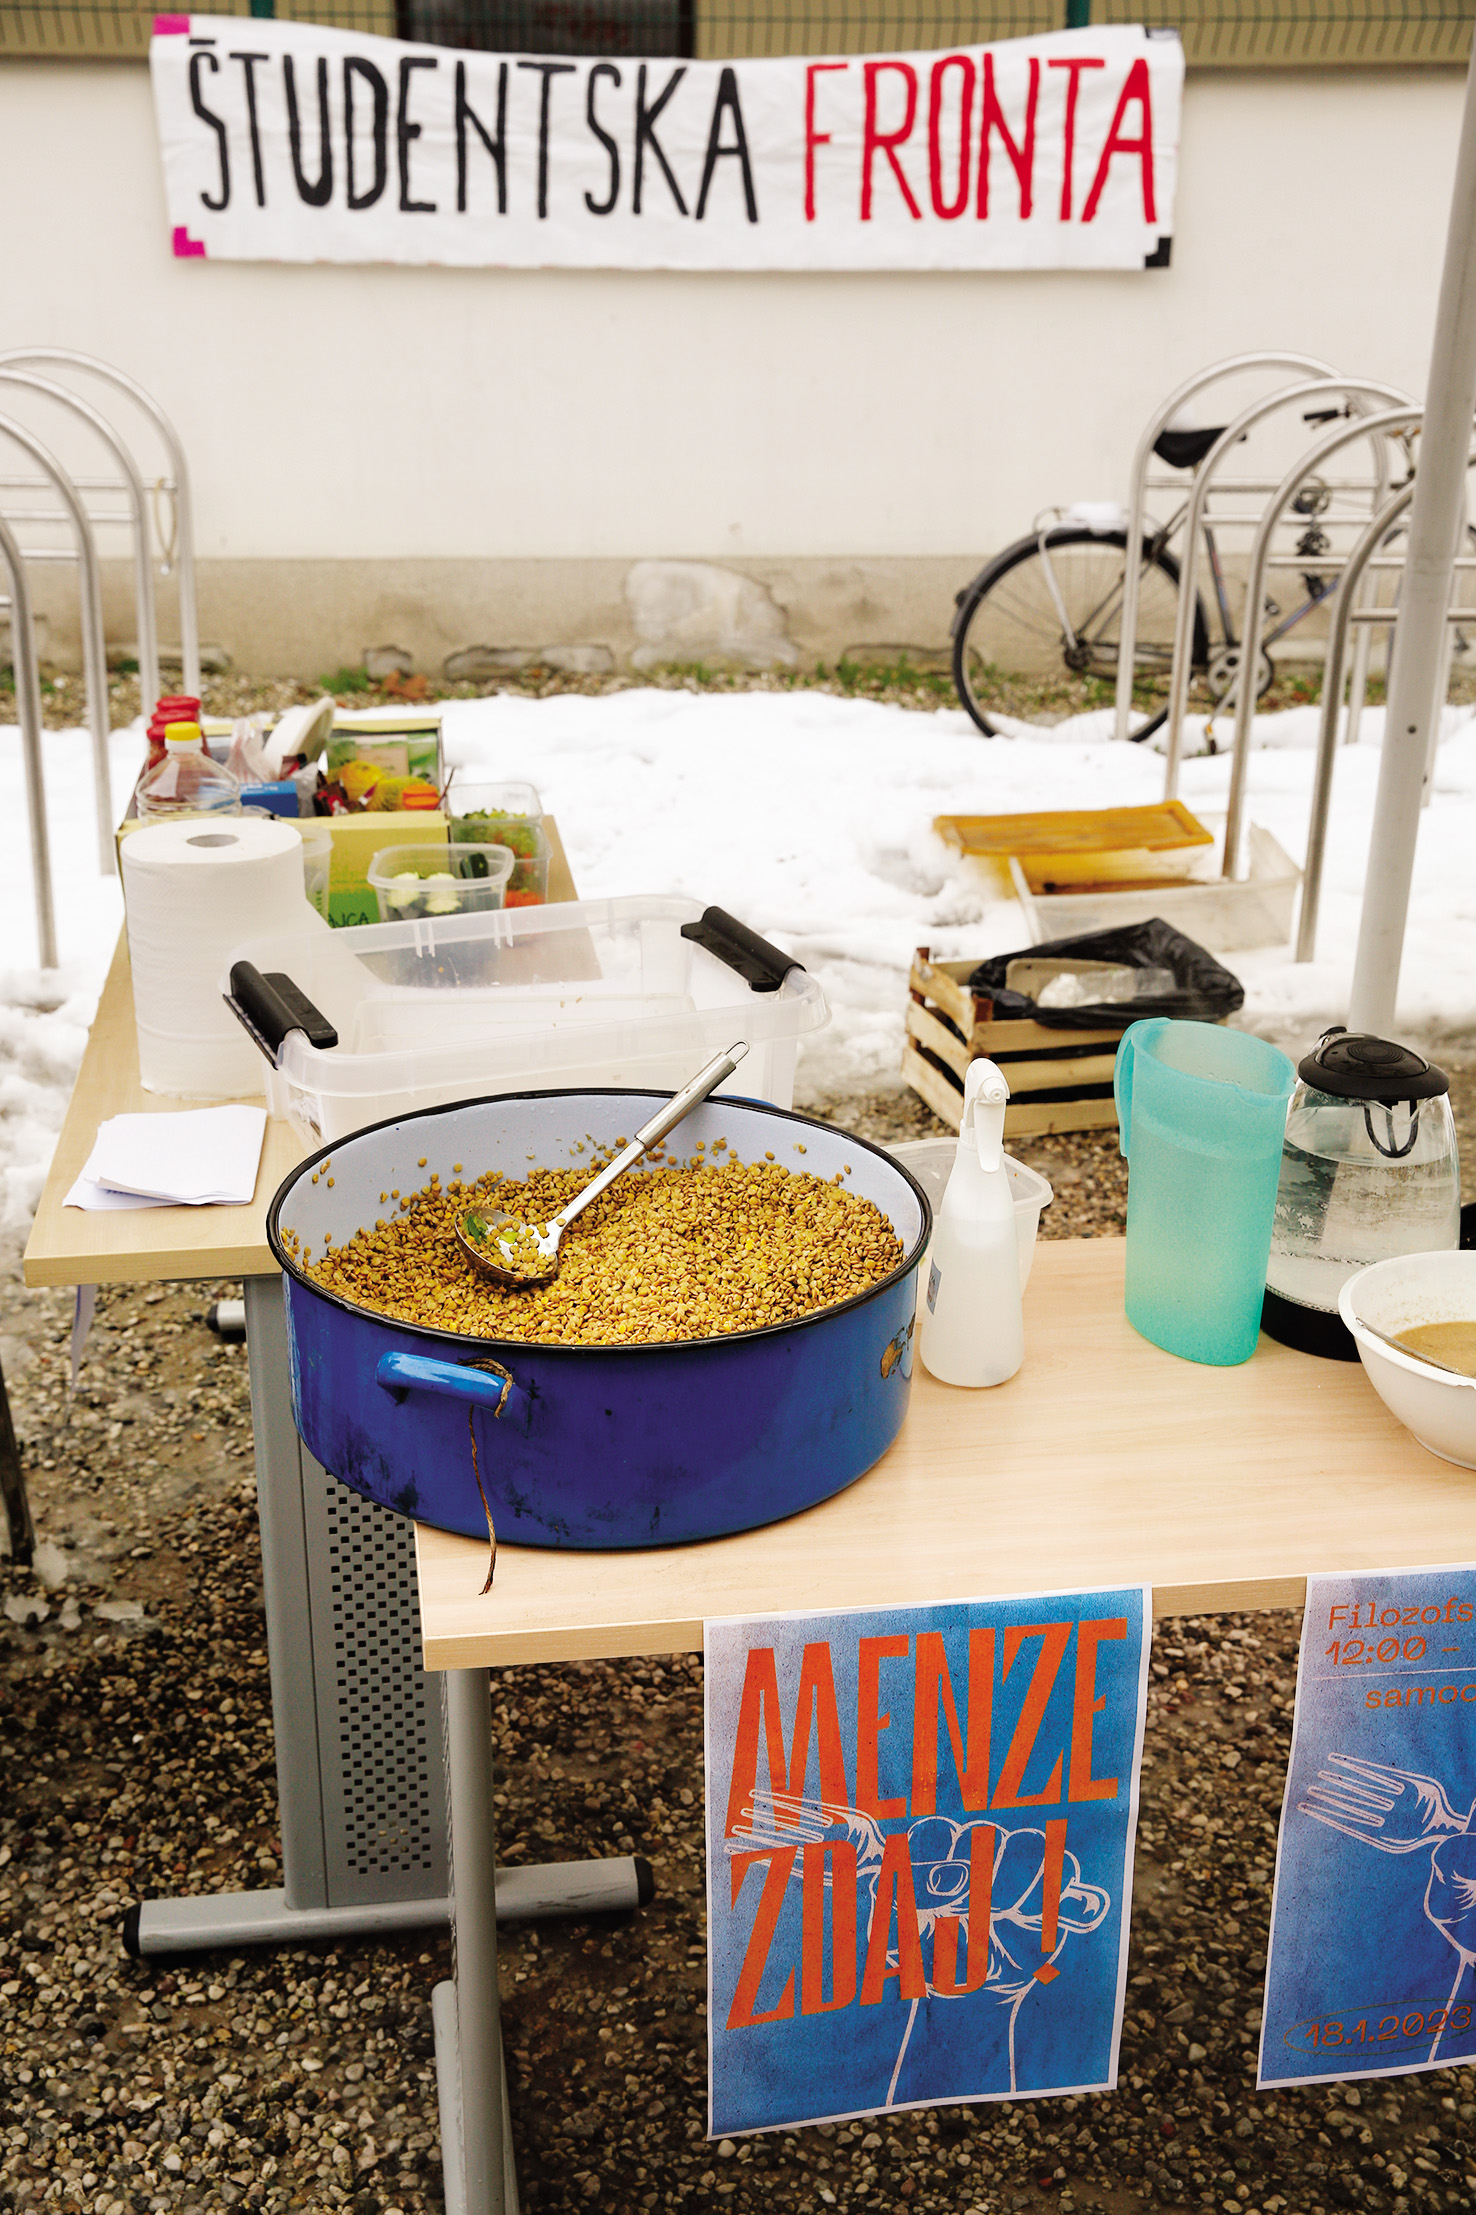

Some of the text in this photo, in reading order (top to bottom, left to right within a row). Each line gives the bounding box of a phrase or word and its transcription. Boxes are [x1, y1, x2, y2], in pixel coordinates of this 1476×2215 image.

[804, 52, 1157, 224] FRONTA
[1328, 1596, 1474, 1630] Filozofs
[1325, 1636, 1427, 1666] 12:00
[724, 1617, 1128, 1839] MENZE
[1305, 2005, 1472, 2047] 18.1.2023
